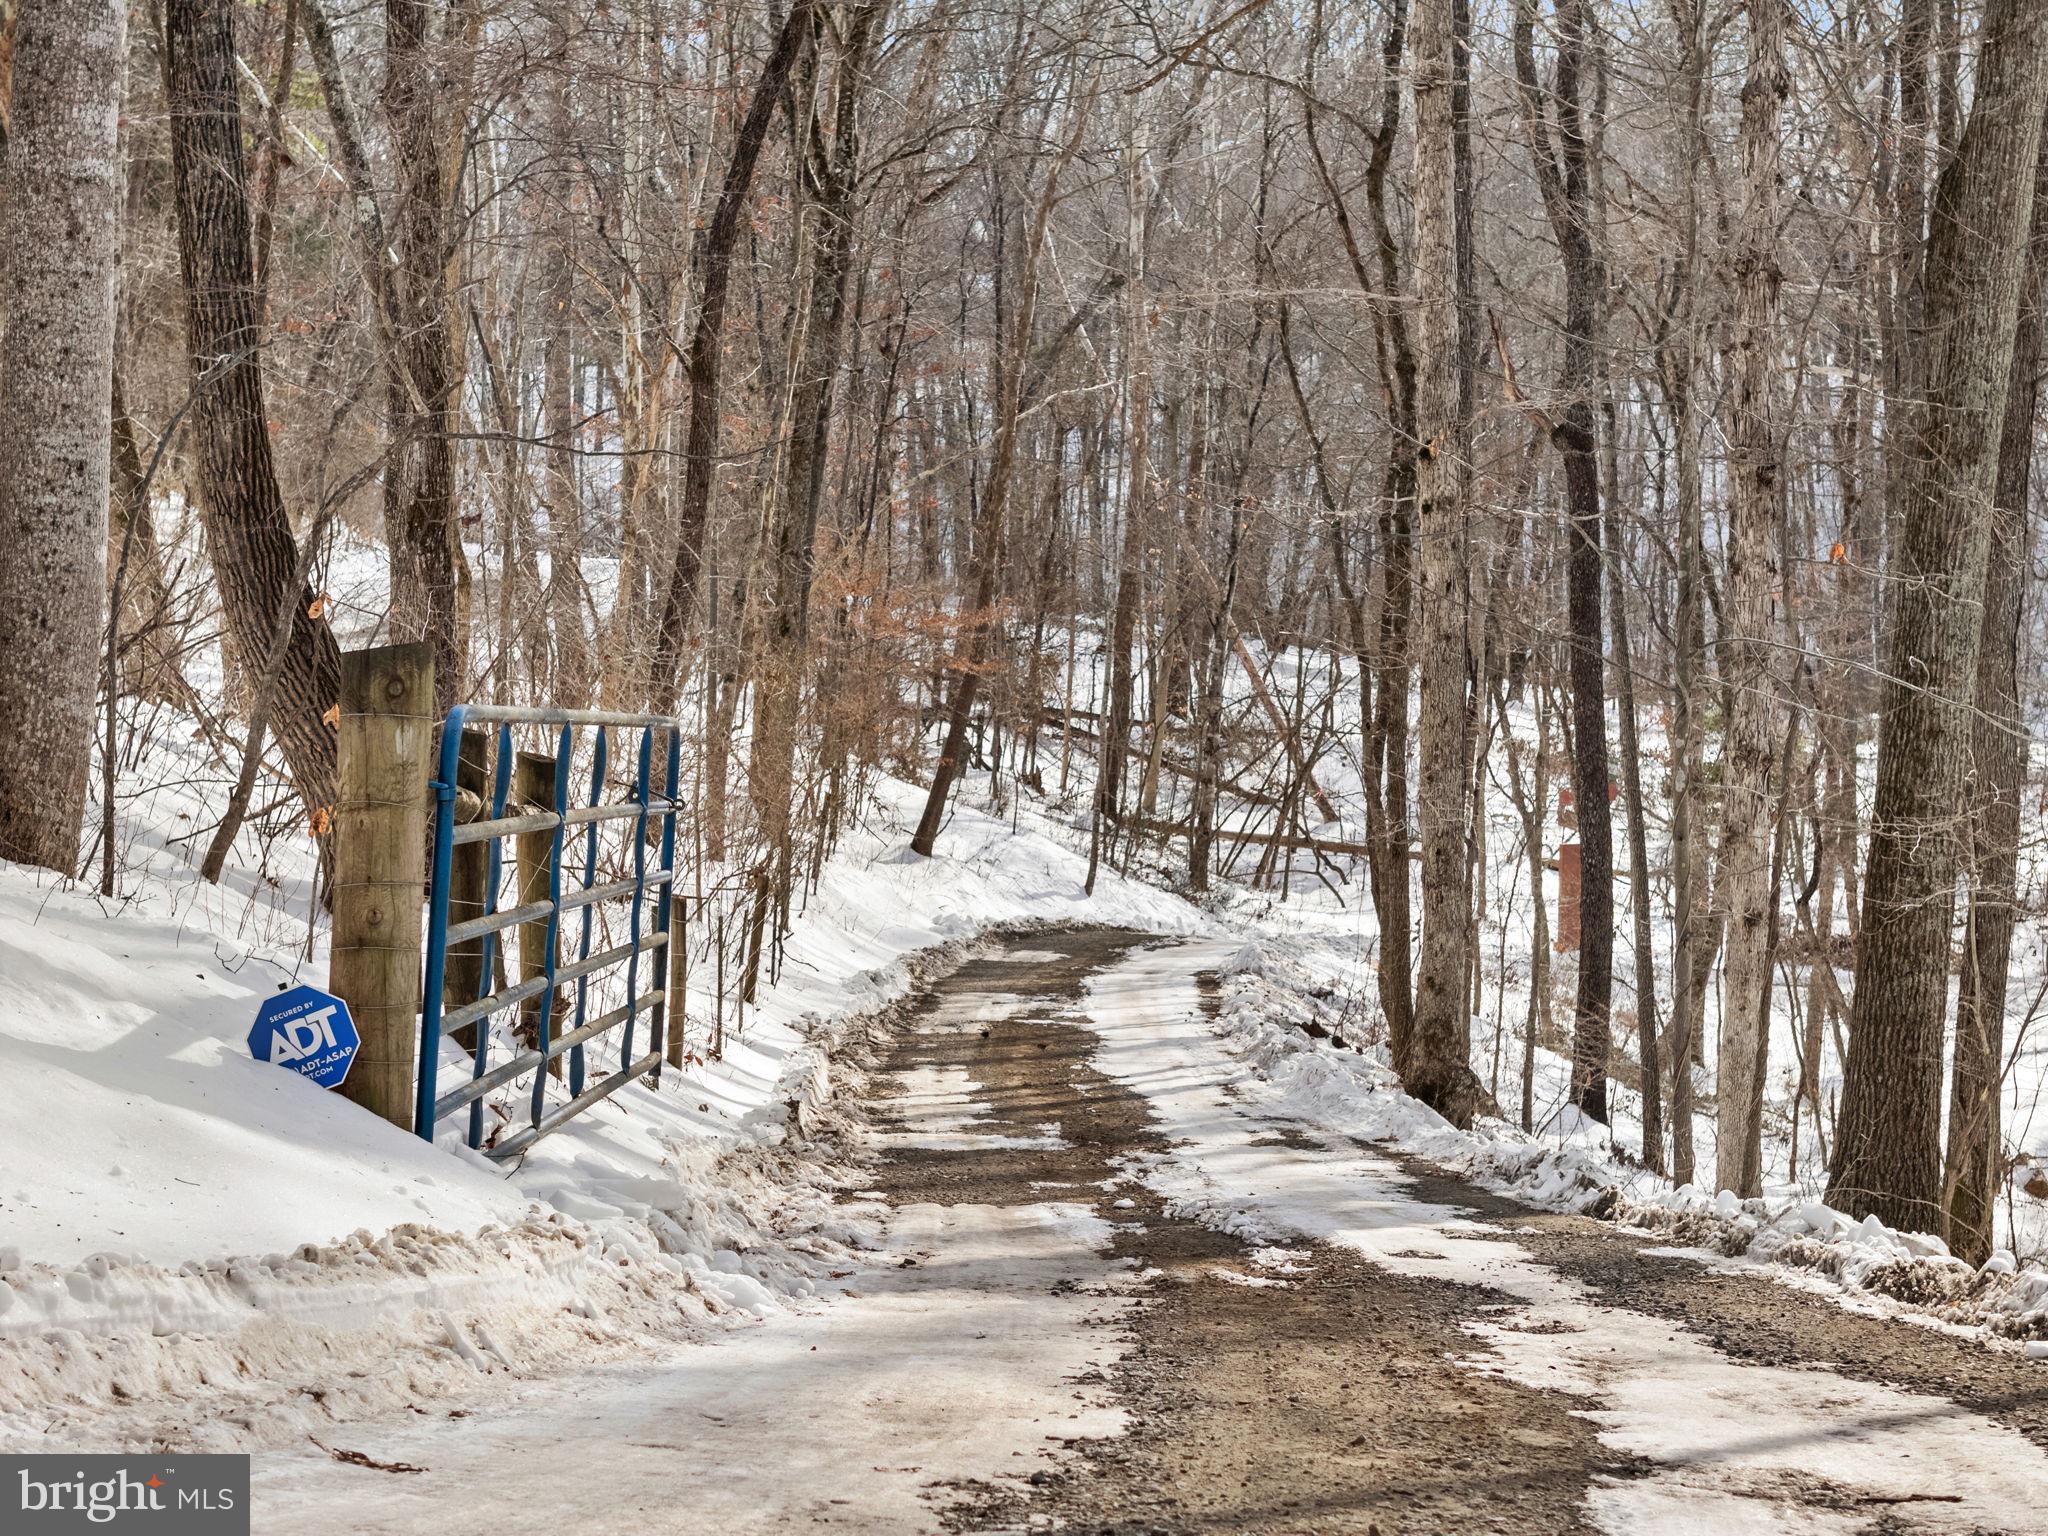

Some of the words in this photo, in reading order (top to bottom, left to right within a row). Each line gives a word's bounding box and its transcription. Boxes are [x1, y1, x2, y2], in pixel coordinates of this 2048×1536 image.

[269, 1005, 303, 1023] SECURED
[304, 1001, 313, 1010] BY
[269, 1004, 337, 1064] ADT
[301, 1046, 352, 1074] ADT-ASAP
